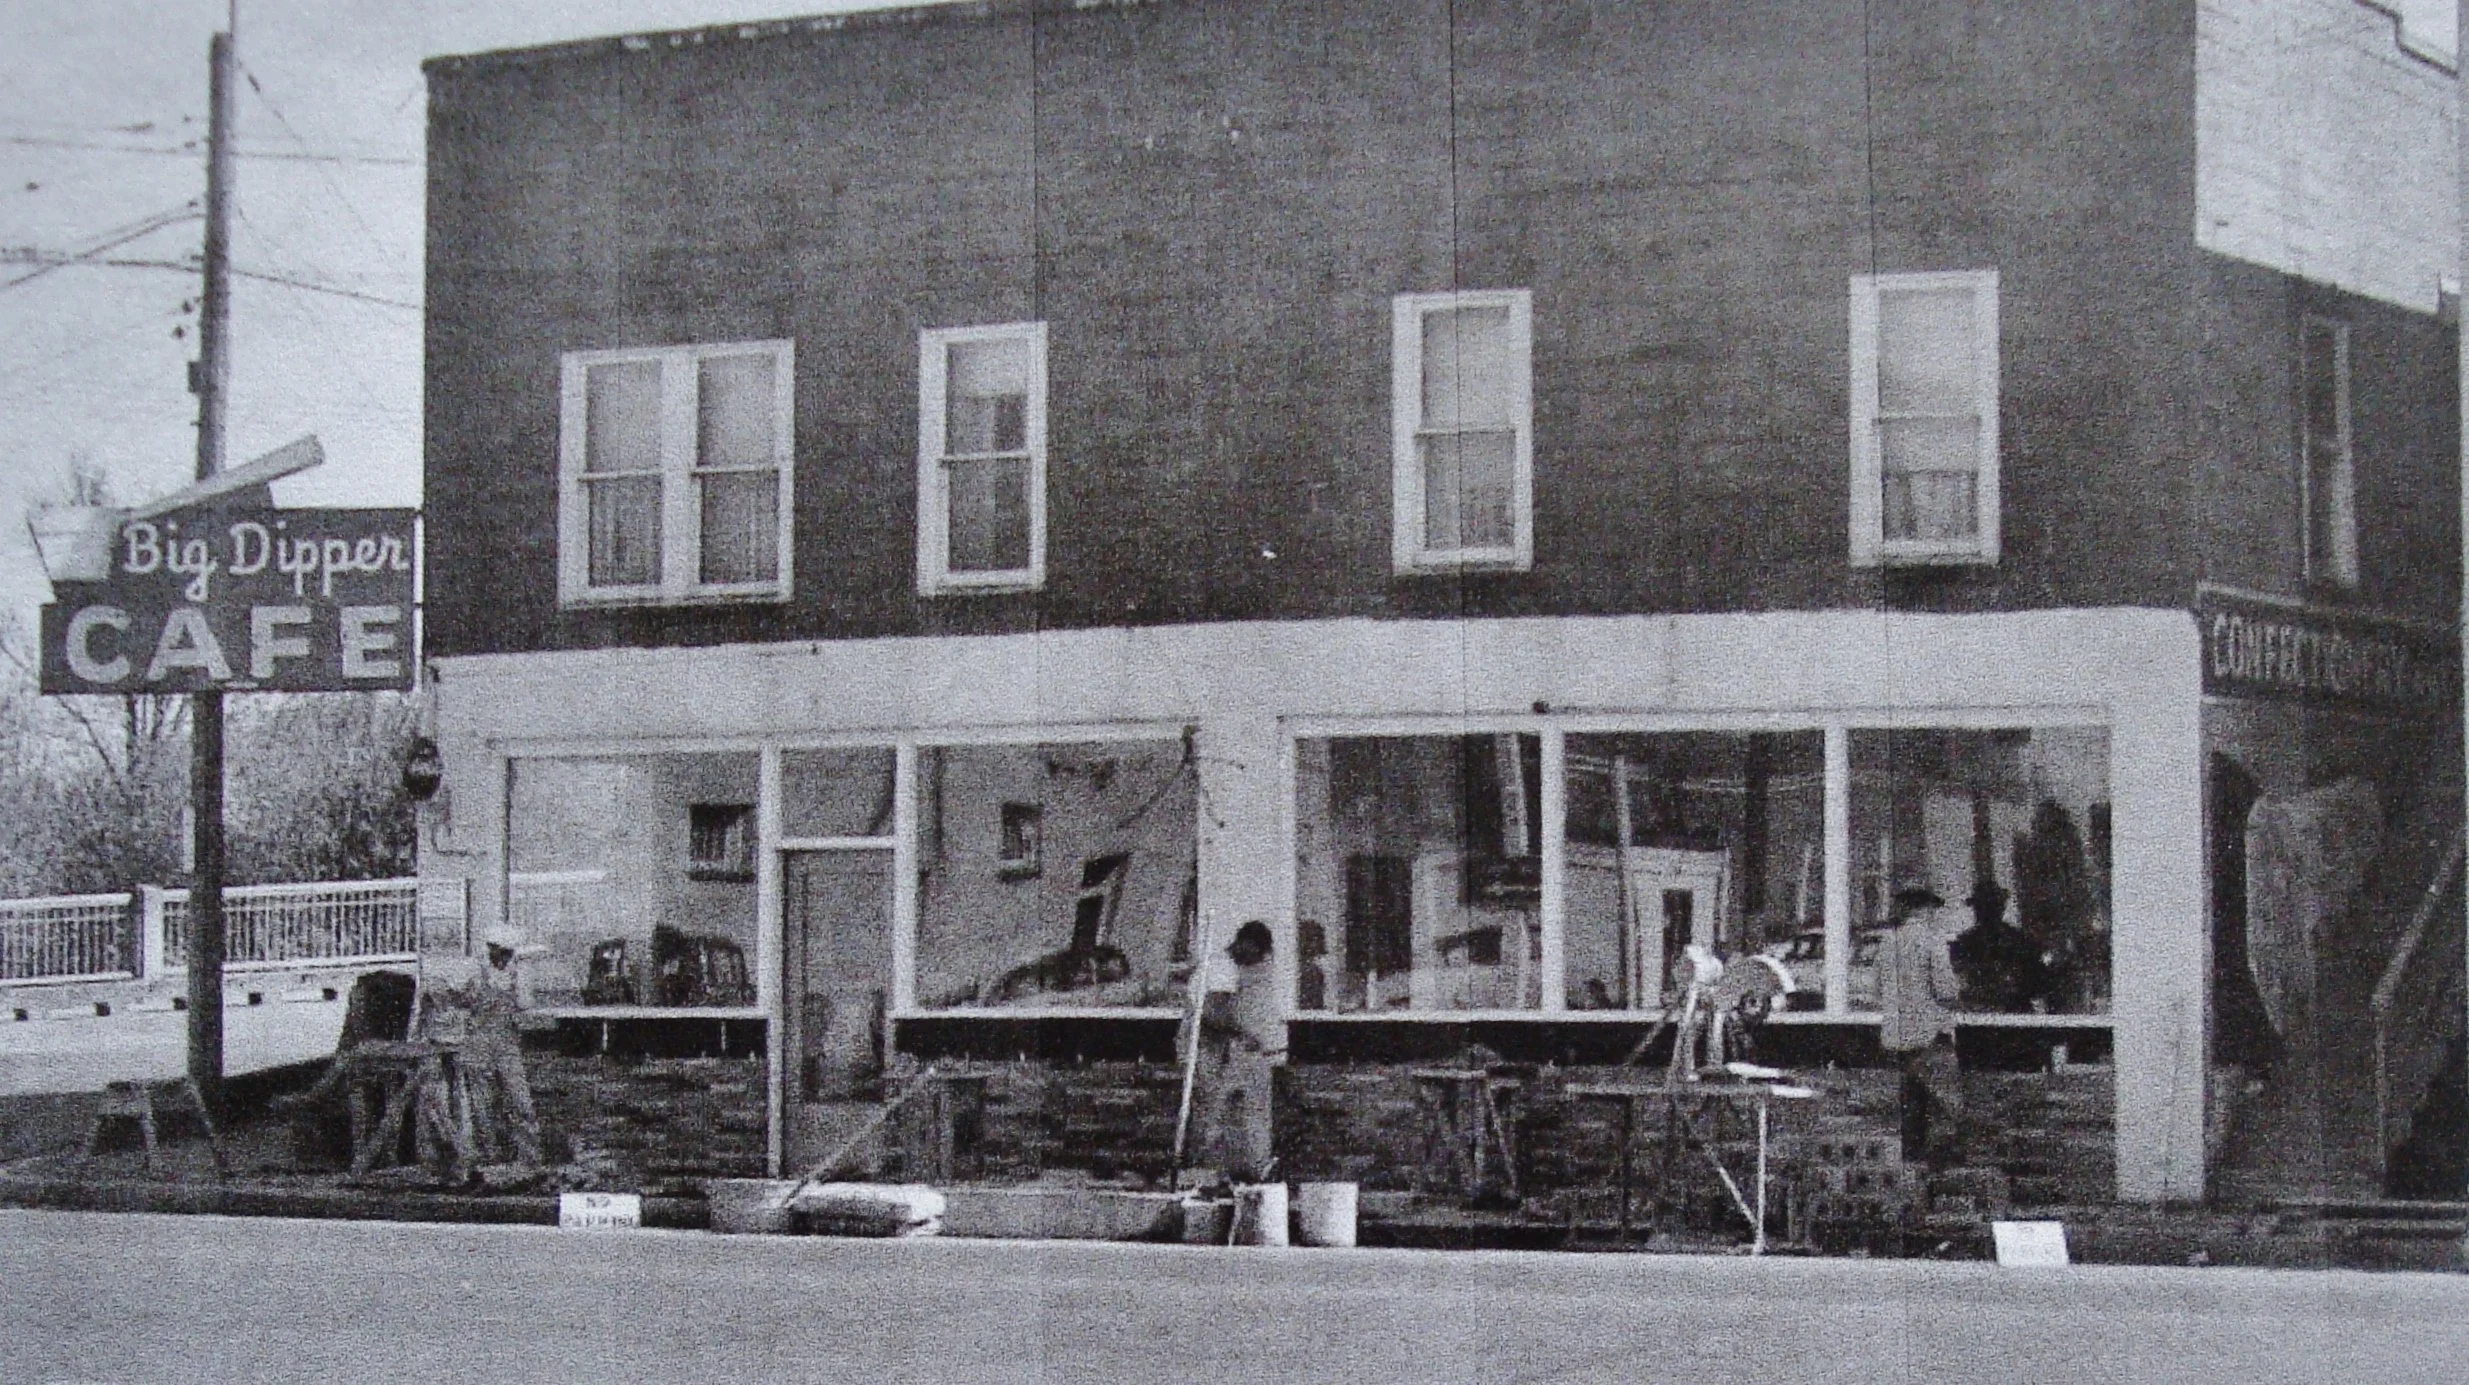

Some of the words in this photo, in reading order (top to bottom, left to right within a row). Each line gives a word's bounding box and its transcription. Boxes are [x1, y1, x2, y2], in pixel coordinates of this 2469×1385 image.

[123, 521, 217, 600] Big
[228, 521, 409, 597] Dipper
[66, 605, 400, 683] CAFE
